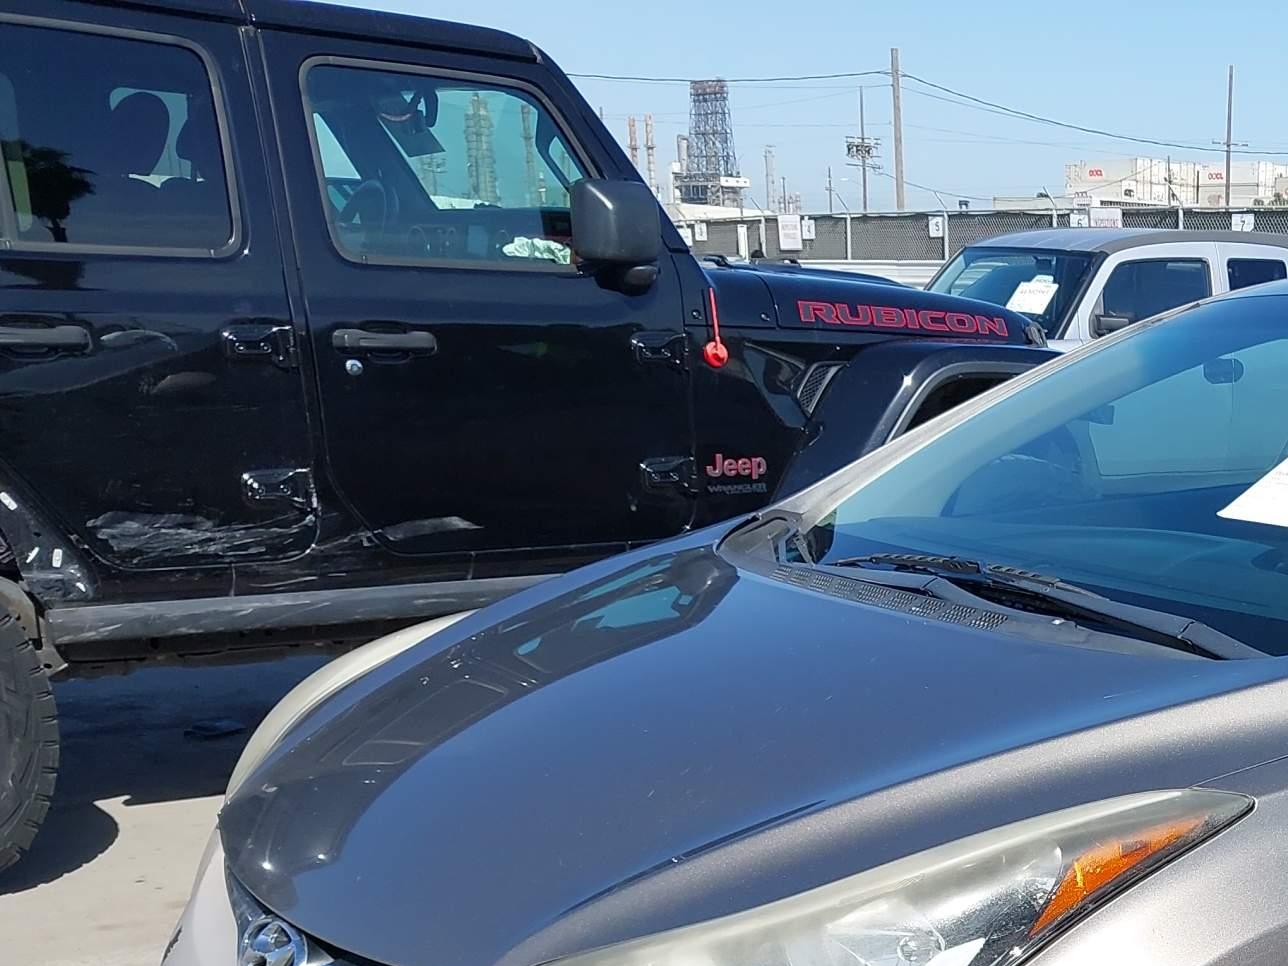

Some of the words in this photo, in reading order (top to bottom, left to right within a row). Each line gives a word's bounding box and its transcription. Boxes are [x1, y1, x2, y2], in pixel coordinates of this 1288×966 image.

[935, 221, 940, 232] 5
[797, 300, 1009, 337] RUBICON
[705, 453, 768, 480] Jeep
